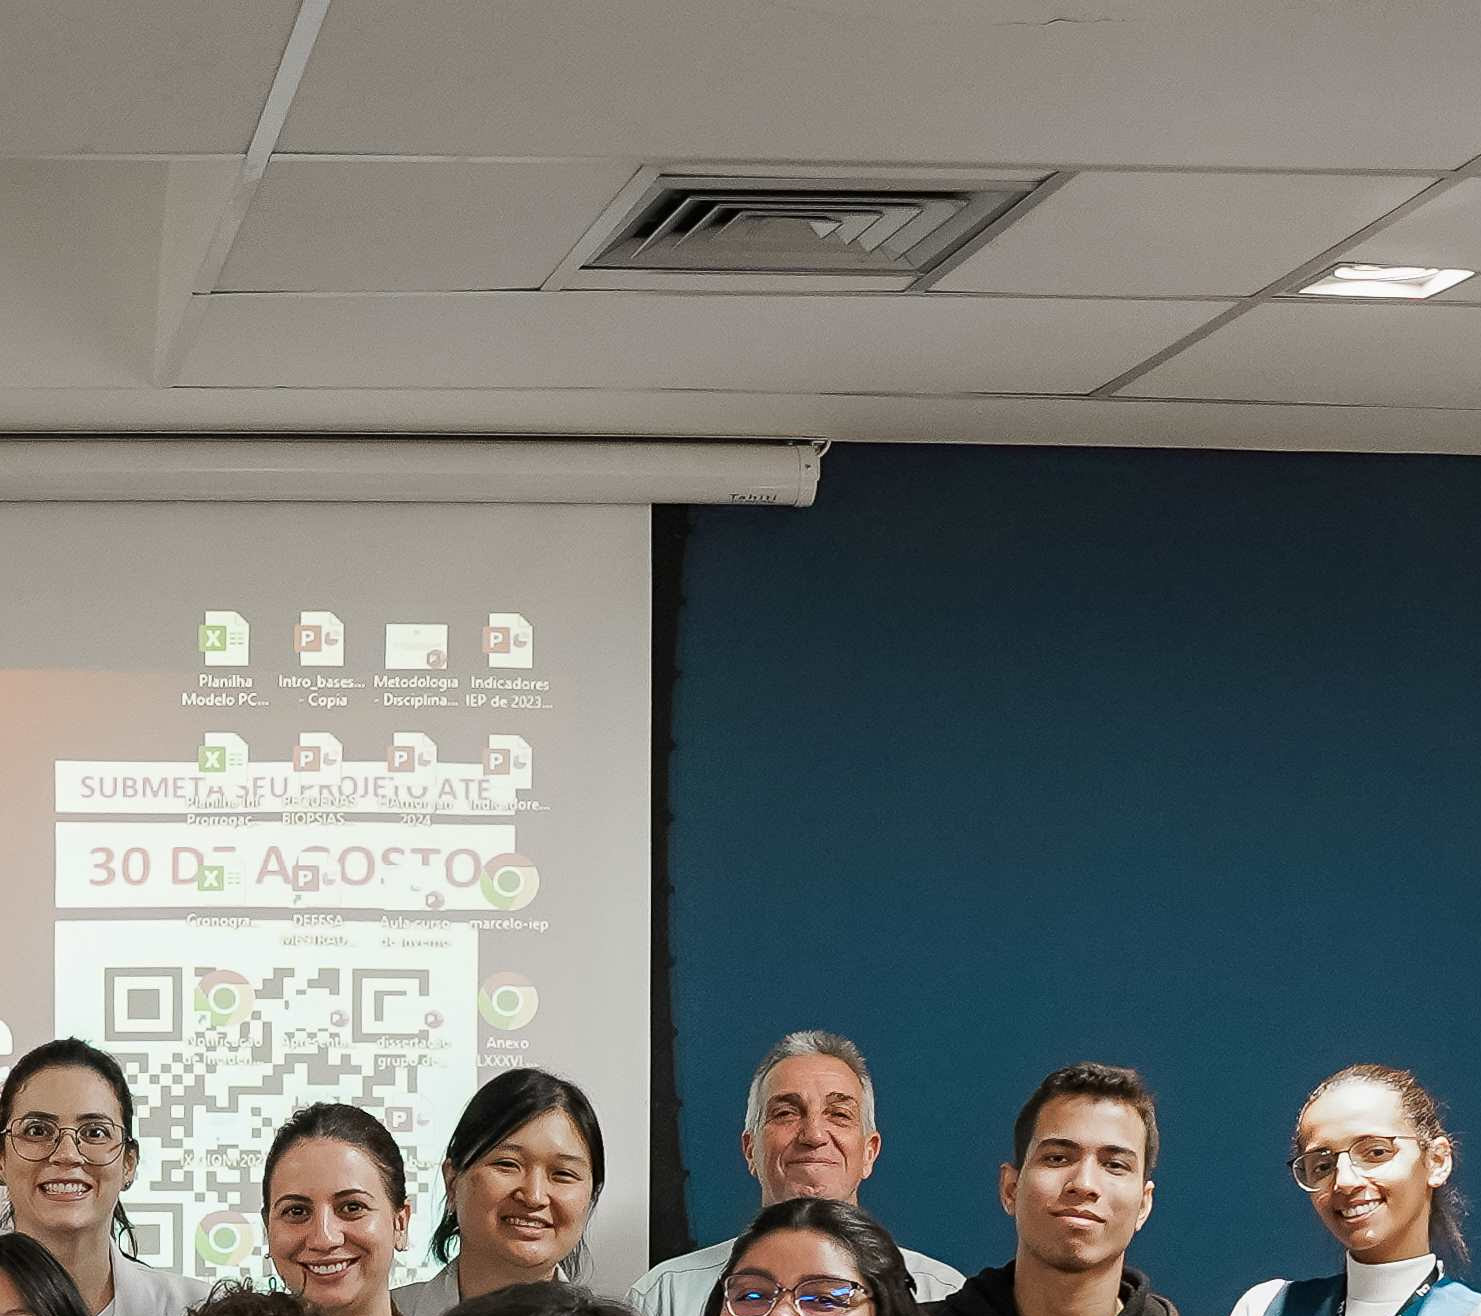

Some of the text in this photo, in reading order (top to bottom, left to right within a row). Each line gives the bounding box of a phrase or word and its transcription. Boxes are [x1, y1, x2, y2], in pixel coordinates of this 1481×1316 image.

[199, 674, 253, 689] Planilha
[373, 674, 459, 691] Metodologia
[471, 676, 550, 692] Indicadores
[181, 693, 235, 708] Modelo
[492, 695, 508, 709] de
[88, 845, 151, 888] 30
[171, 845, 237, 887] D
[469, 917, 550, 934] marcelo-iep
[486, 1036, 530, 1050] Anexo
